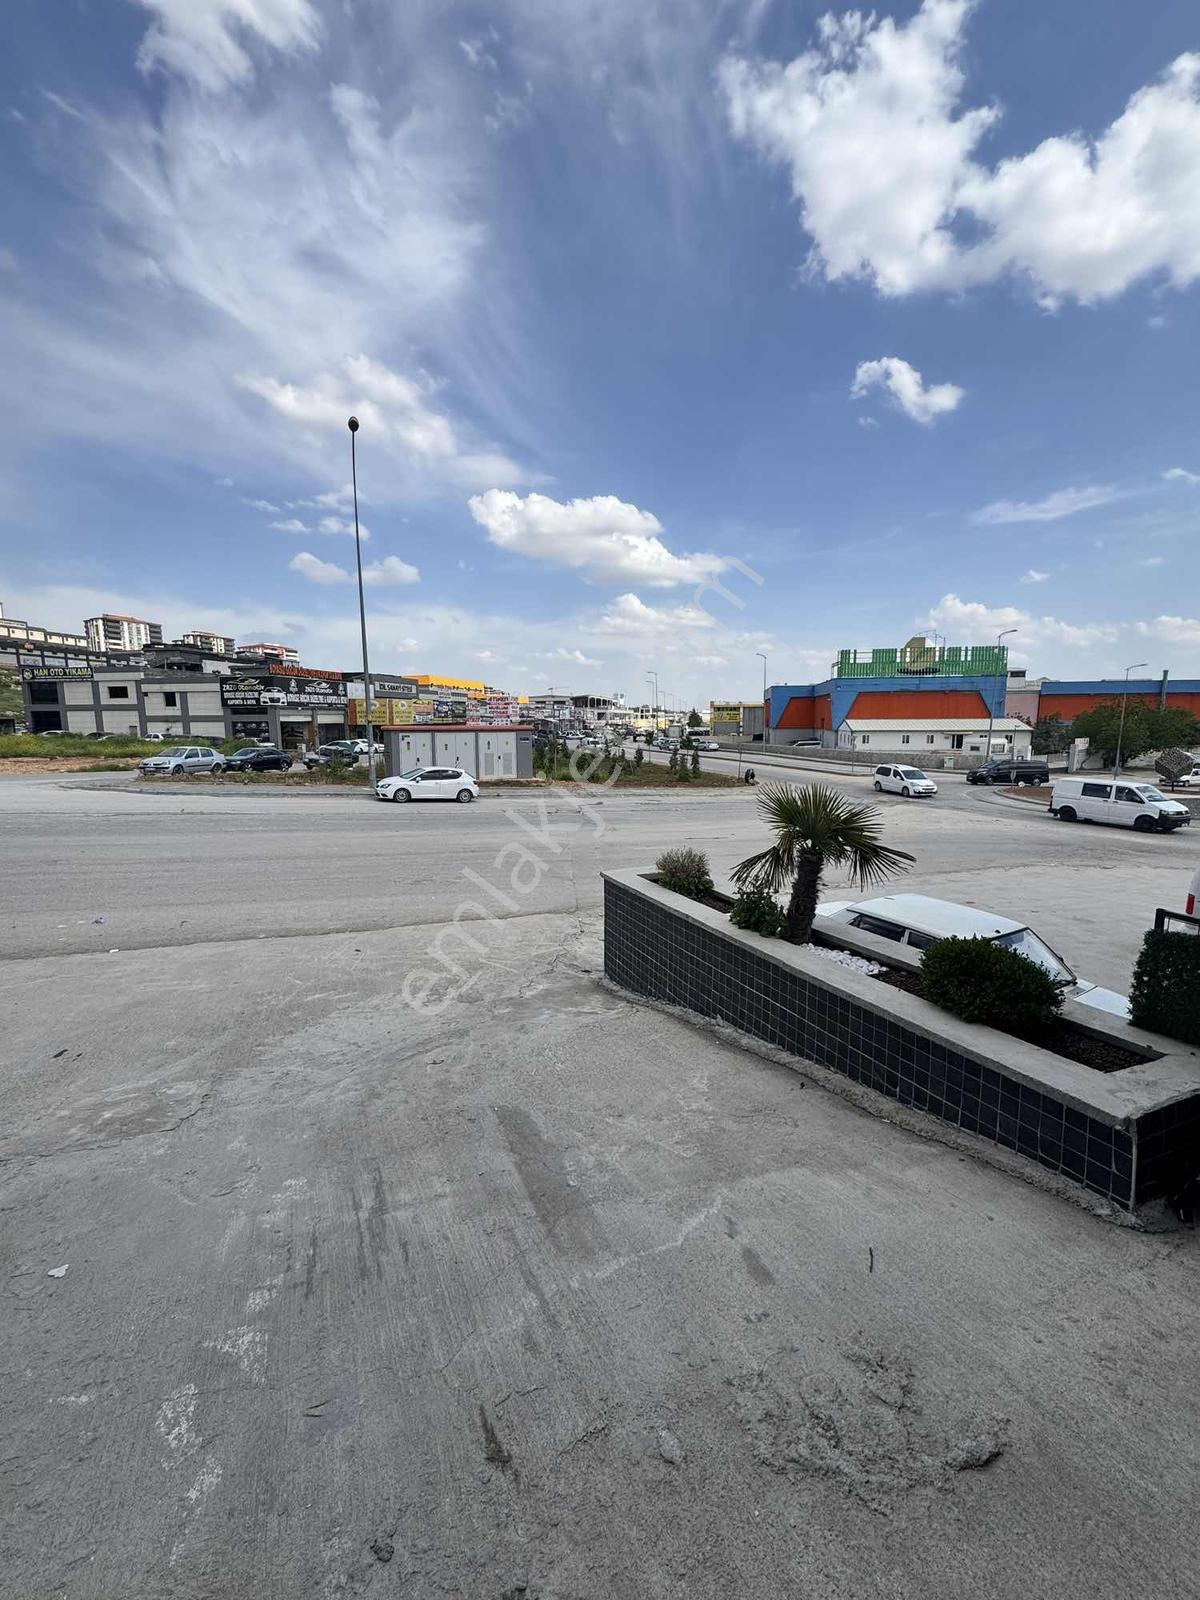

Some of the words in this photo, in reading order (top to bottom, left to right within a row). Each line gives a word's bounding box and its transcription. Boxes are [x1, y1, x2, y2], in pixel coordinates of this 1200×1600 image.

[33, 668, 48, 676] HAN
[49, 668, 64, 676] OTO
[65, 668, 92, 676] YIKAMA
